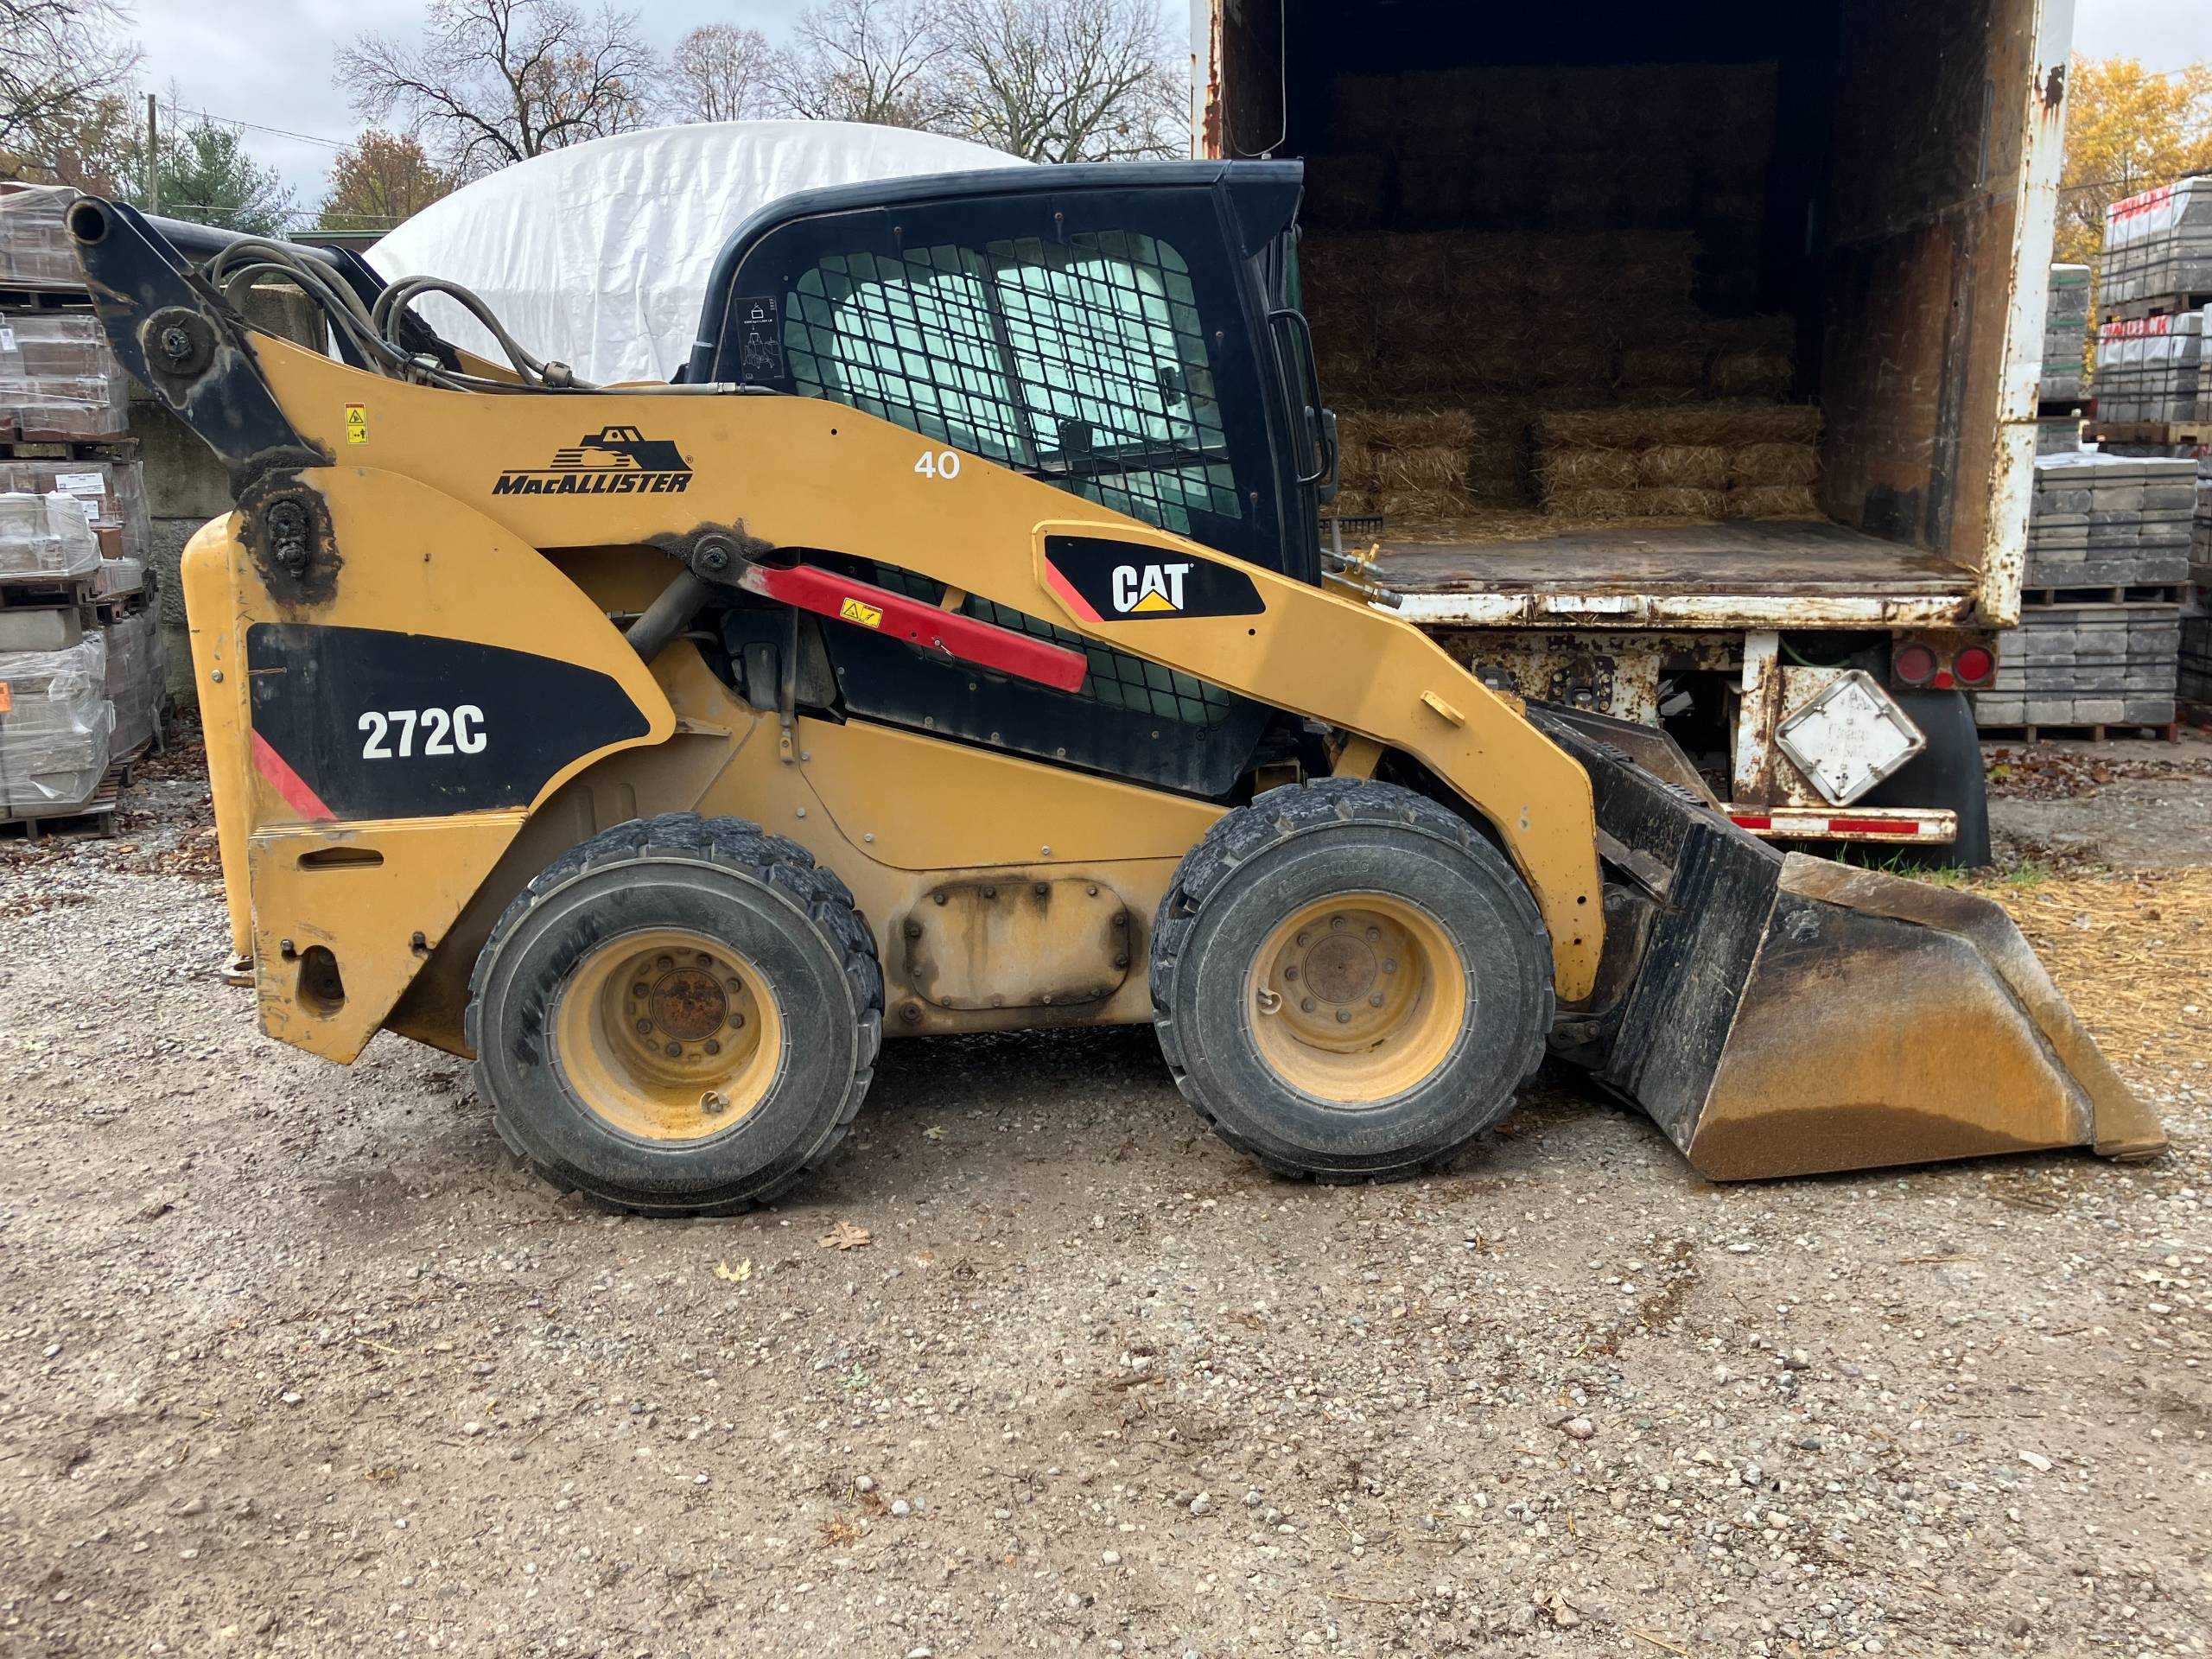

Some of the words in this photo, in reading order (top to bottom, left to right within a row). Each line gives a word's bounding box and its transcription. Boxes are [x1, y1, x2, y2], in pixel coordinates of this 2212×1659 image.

[914, 450, 960, 480] 40
[1112, 563, 1189, 613] CAT
[358, 704, 487, 760] 272C
